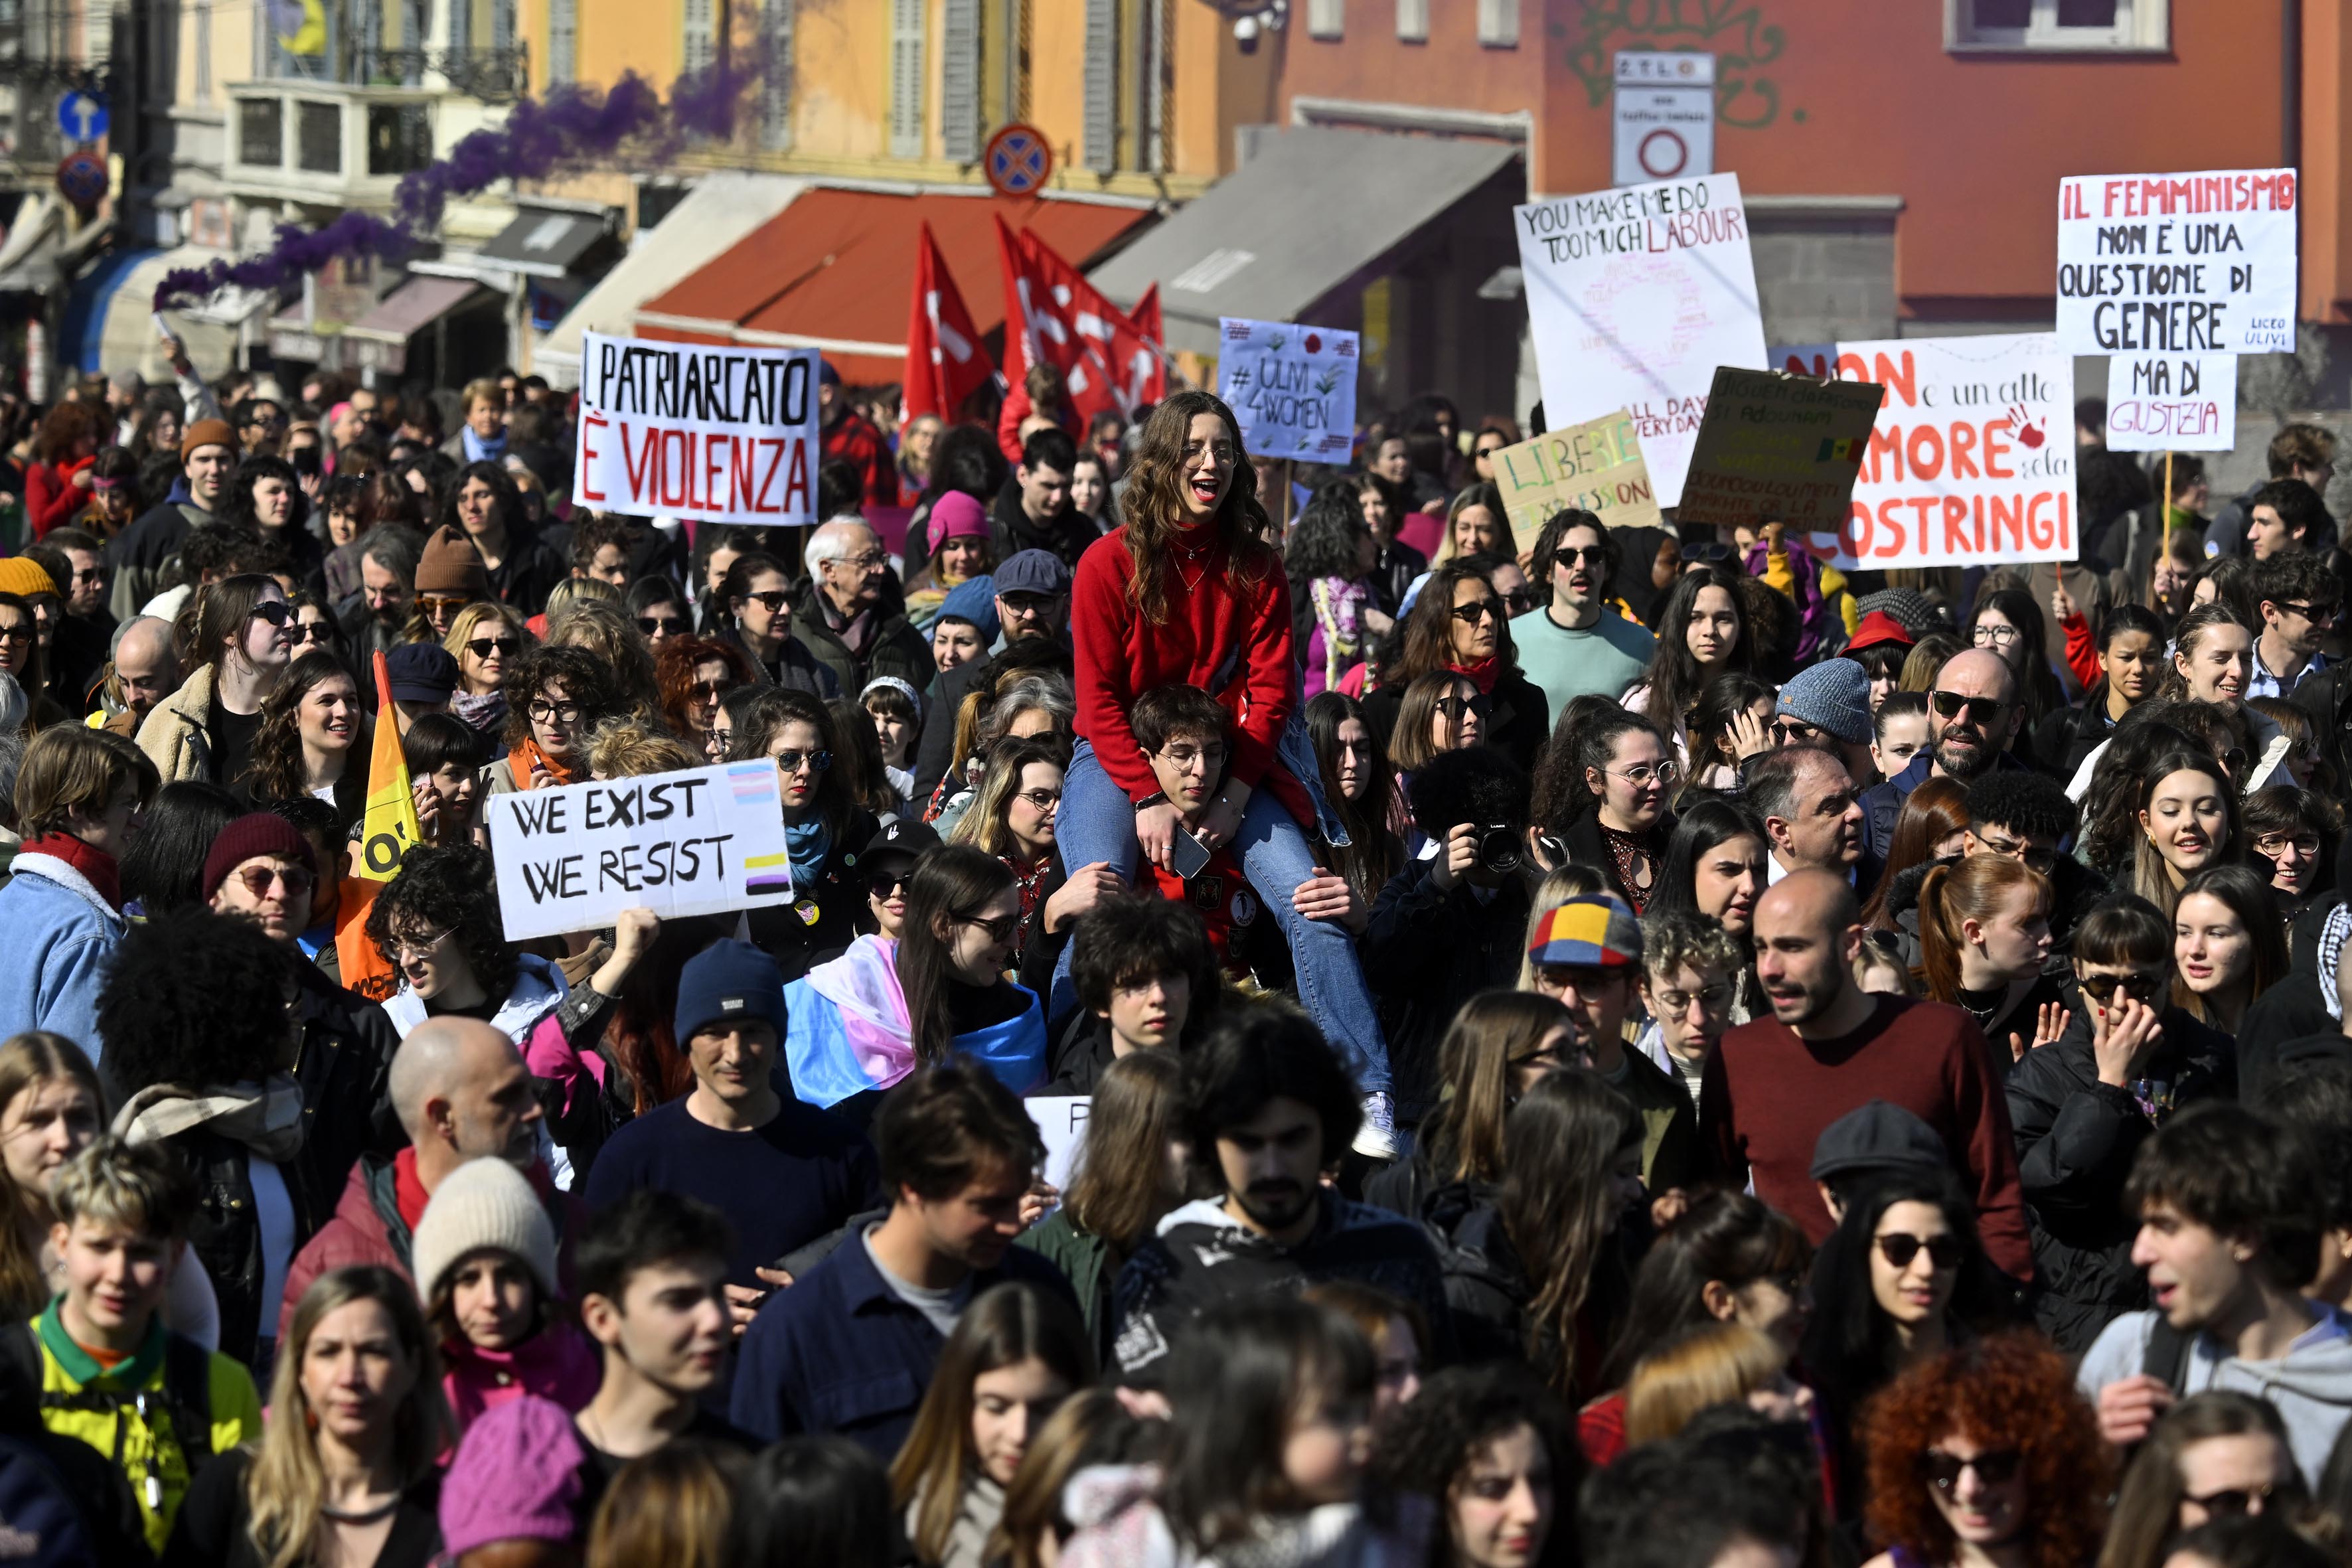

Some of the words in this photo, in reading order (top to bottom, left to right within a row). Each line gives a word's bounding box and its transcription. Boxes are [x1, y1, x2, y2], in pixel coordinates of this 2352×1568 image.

[1523, 202, 1569, 235] YOU
[1577, 193, 1636, 226] MAKE
[1642, 187, 1673, 216] ME
[1678, 181, 1709, 212] DO
[2063, 184, 2090, 220] IL
[2103, 173, 2295, 217] FEMMINISMO
[1541, 233, 1583, 264] TOO
[1586, 222, 1642, 256] MUCH
[1647, 206, 1743, 253] LABOUR
[2097, 224, 2147, 255] NON
[2156, 219, 2176, 255] È
[2185, 224, 2244, 255] UNA
[2060, 264, 2206, 297] QUESTIONE
[2231, 264, 2252, 293] DI
[2093, 301, 2227, 351] GENERE
[2244, 333, 2286, 346] ULIVI
[2252, 317, 2286, 329] LICEO
[600, 344, 810, 426] PATRIARCATO
[1952, 382, 1990, 406] un
[2133, 359, 2170, 395] MA
[2180, 359, 2200, 396] DI
[2110, 400, 2219, 435] GIUSTIZIA
[583, 410, 609, 501] È
[620, 422, 810, 514] VIOLENZA
[510, 795, 567, 838] WE
[586, 778, 709, 830] EXIST
[522, 854, 588, 905] WE
[599, 834, 734, 894] RESIST
